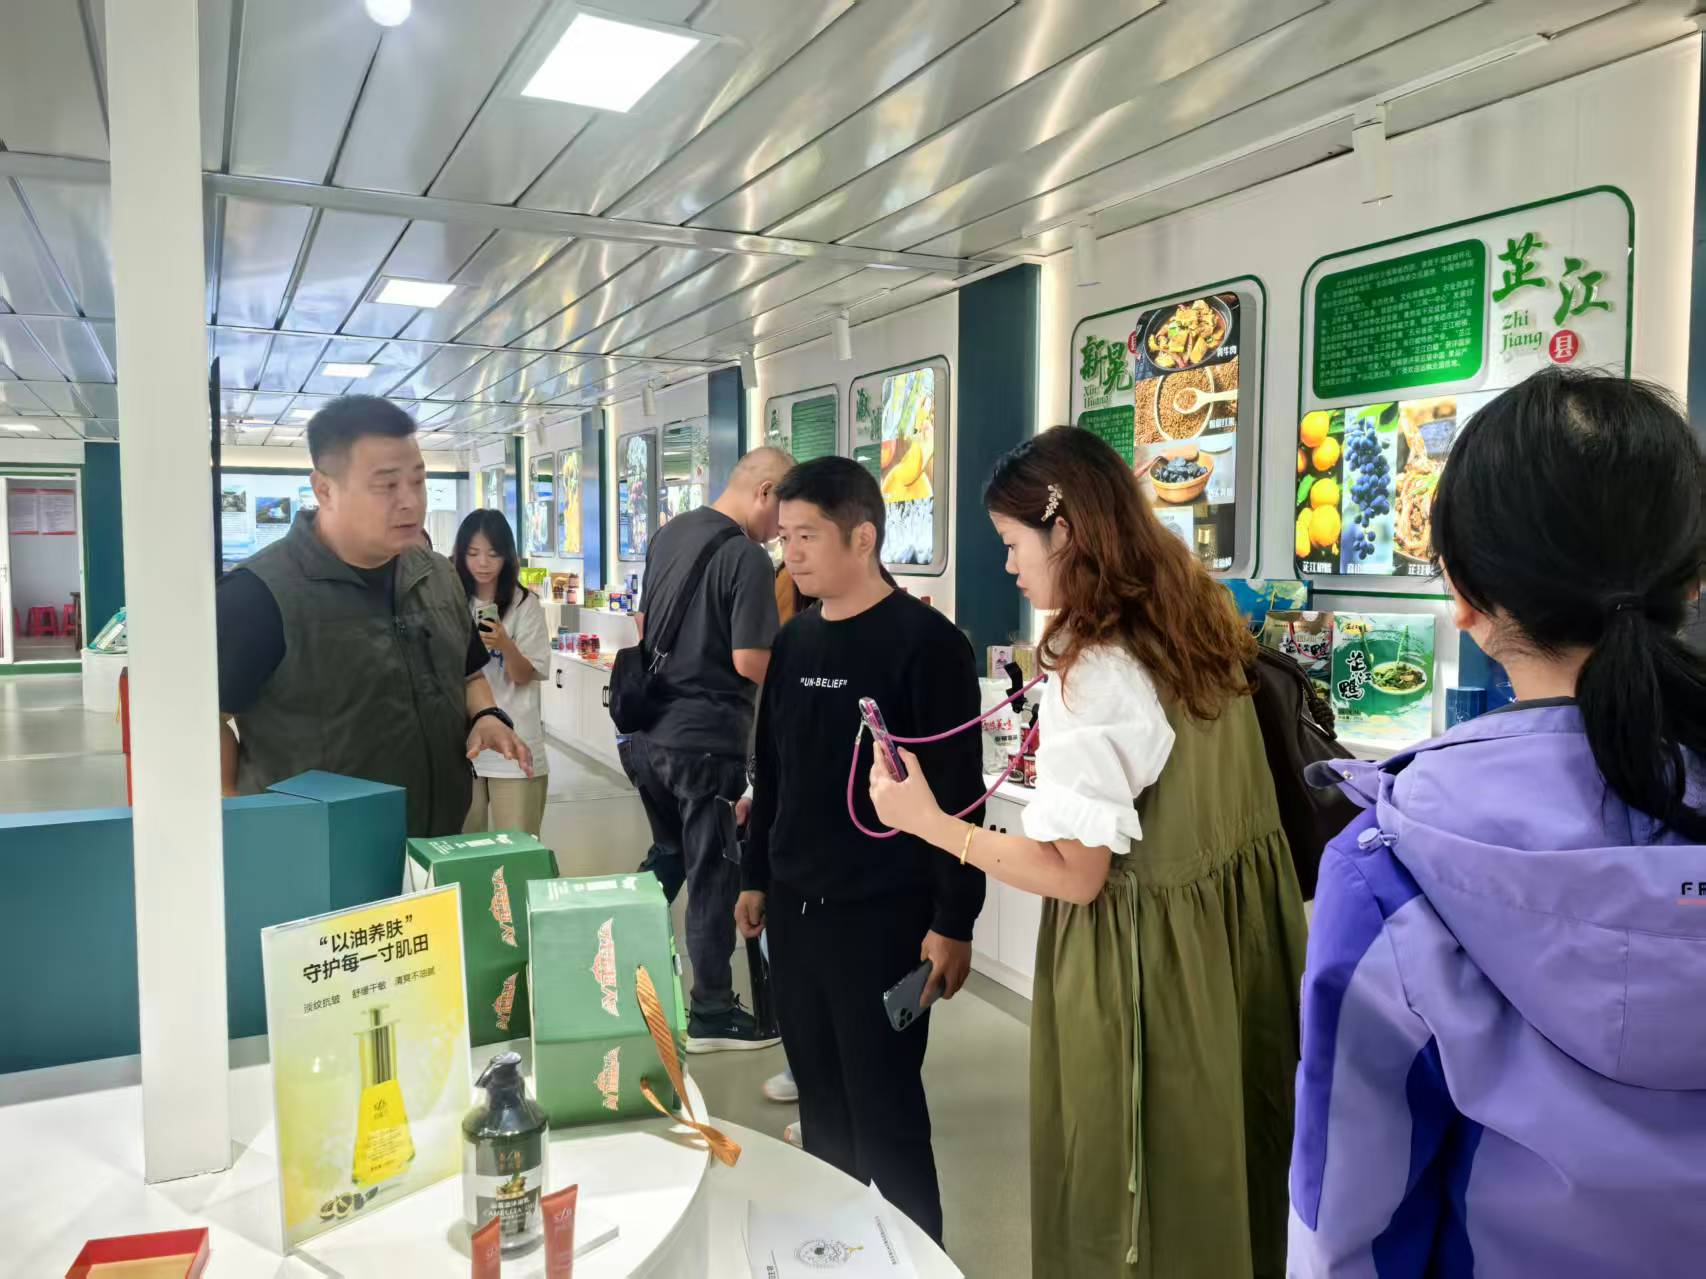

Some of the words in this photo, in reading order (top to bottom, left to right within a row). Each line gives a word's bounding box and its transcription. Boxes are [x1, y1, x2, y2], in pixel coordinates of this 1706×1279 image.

[1492, 231, 1610, 327] 芷江
[1501, 331, 1543, 353] Jiang
[1554, 335, 1574, 359] 县
[1079, 335, 1133, 395] 新晃
[1337, 650, 1373, 700] 芷江鸭
[302, 933, 429, 984] 守护每一寸肌田
[394, 966, 436, 986] 清爽不油腻
[303, 994, 341, 1014] 淡纹抗皱
